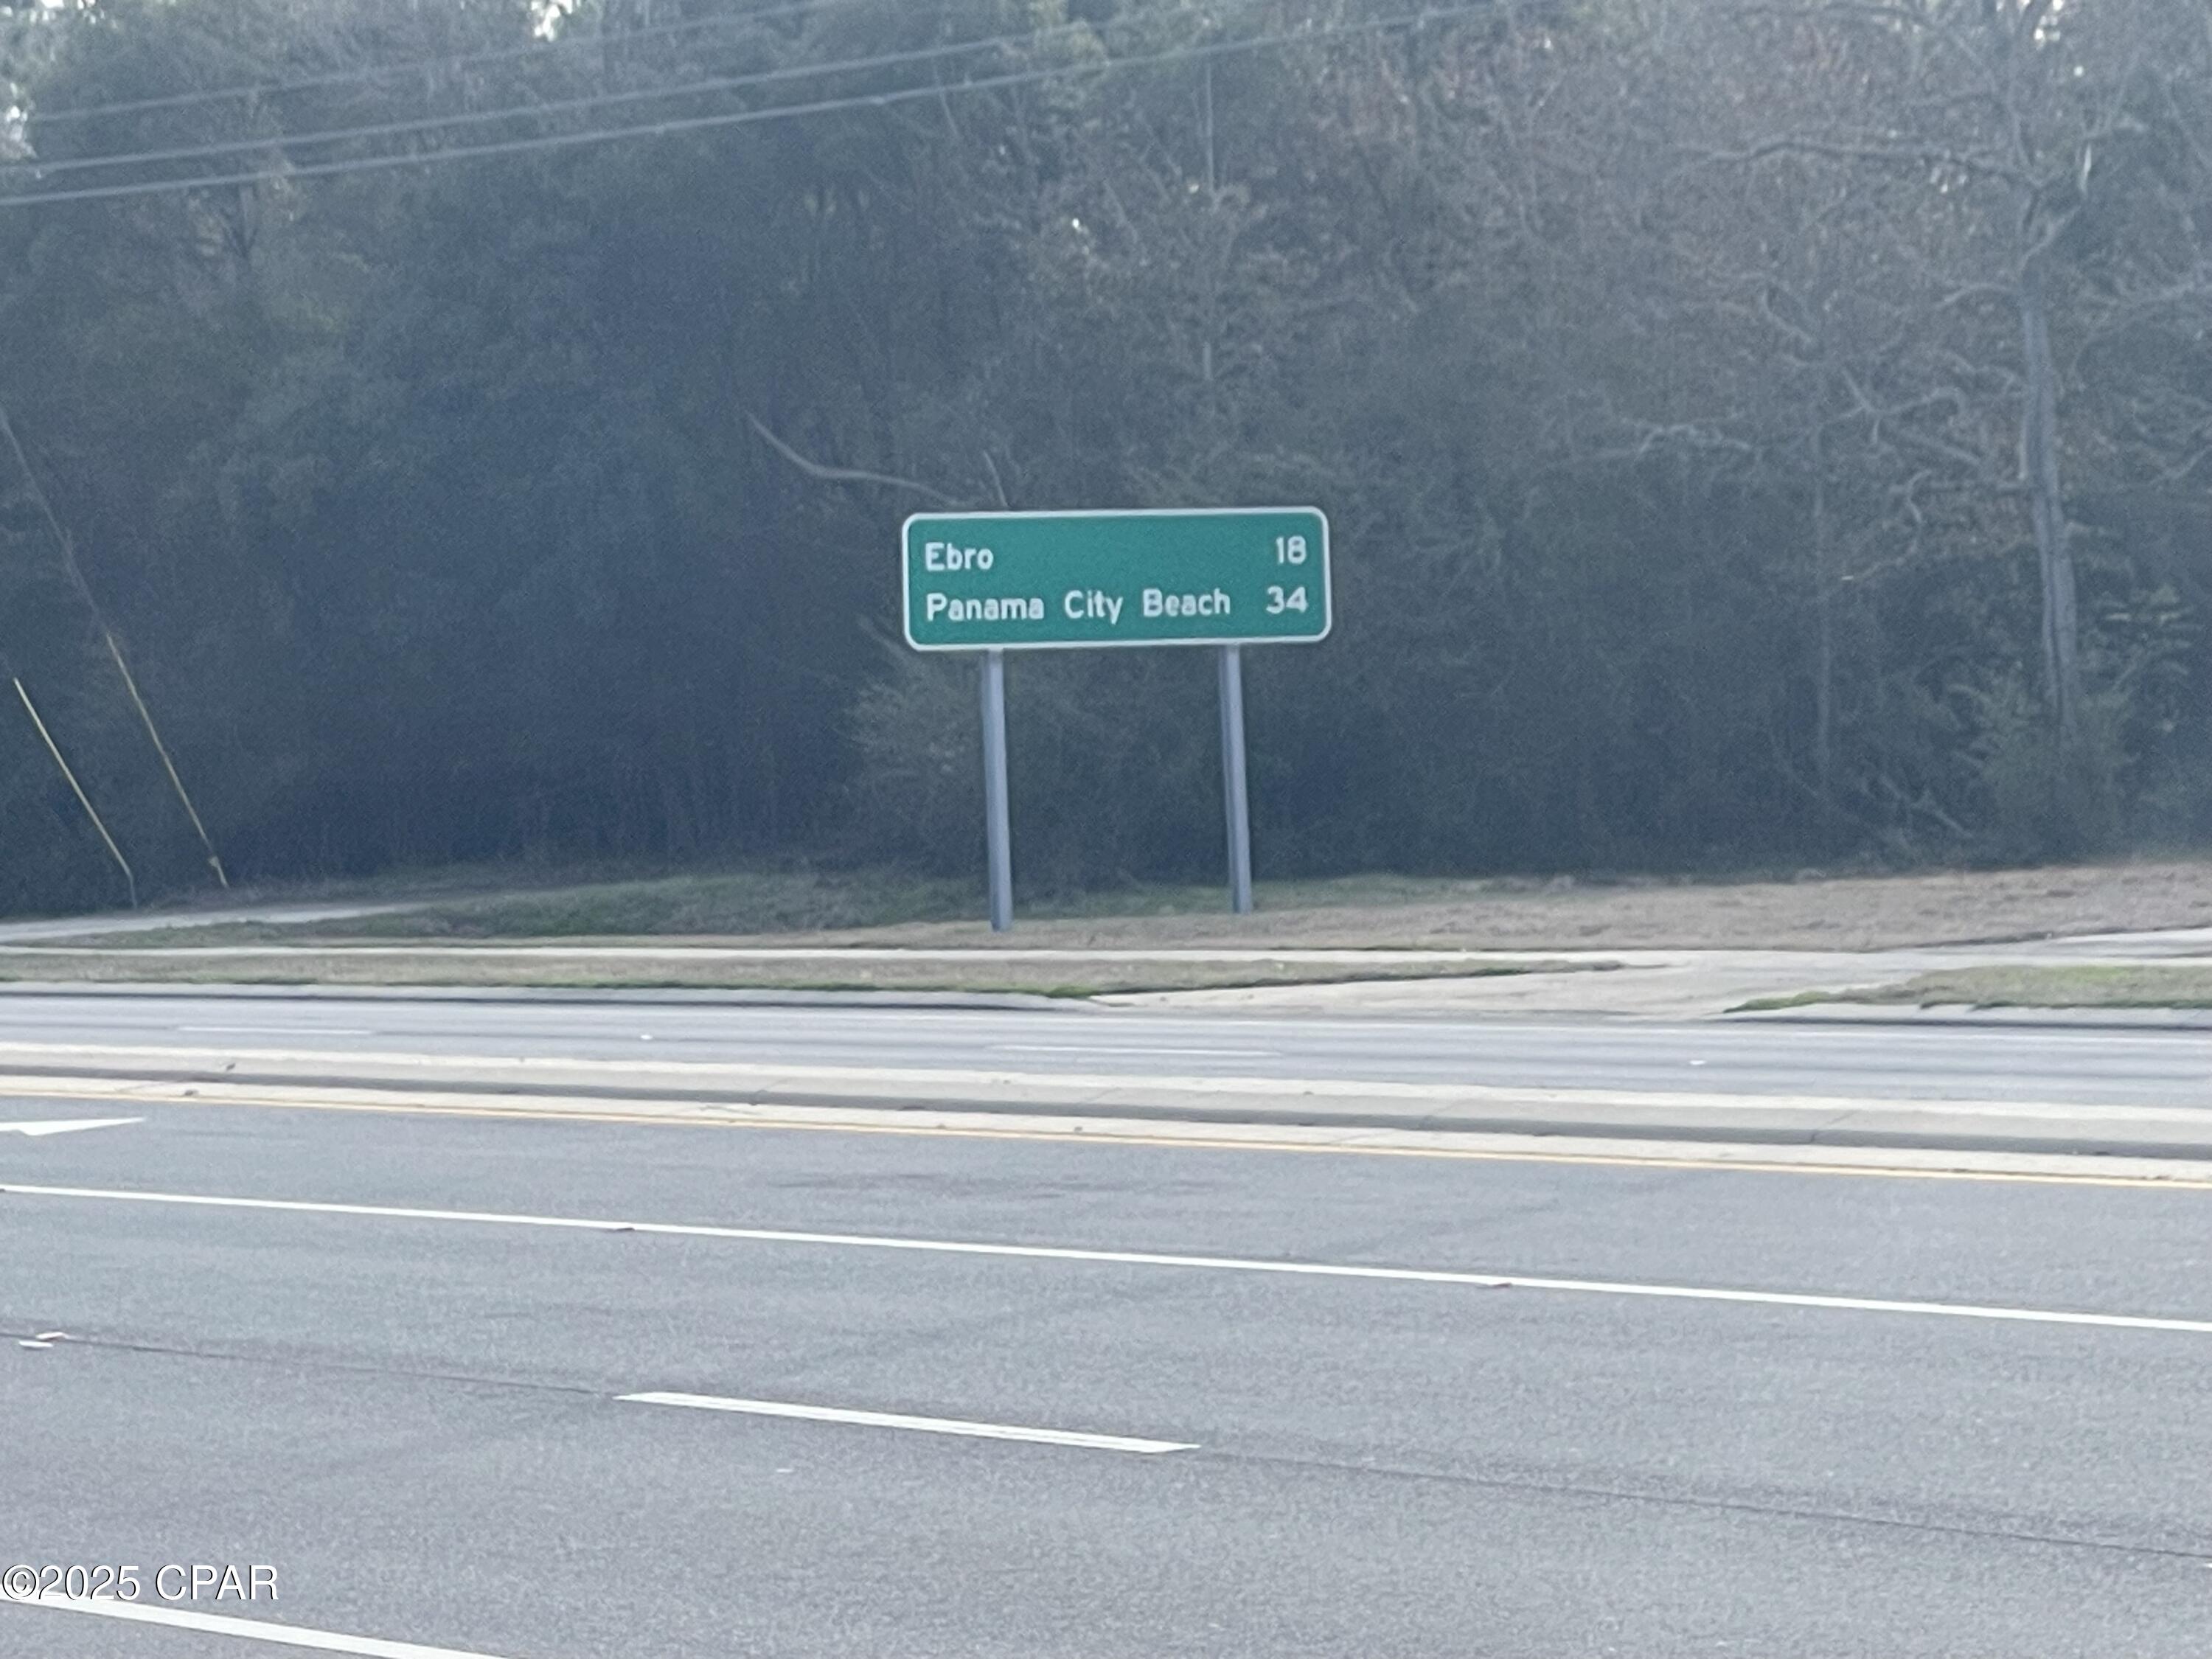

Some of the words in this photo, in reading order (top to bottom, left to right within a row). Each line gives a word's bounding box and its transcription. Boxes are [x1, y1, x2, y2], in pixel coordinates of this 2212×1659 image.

[925, 541, 995, 571] Ebro
[1276, 535, 1307, 565] 18
[926, 592, 1045, 622] Panama
[1064, 589, 1124, 625] City
[1143, 588, 1231, 617] Beach
[1265, 585, 1308, 614] 34
